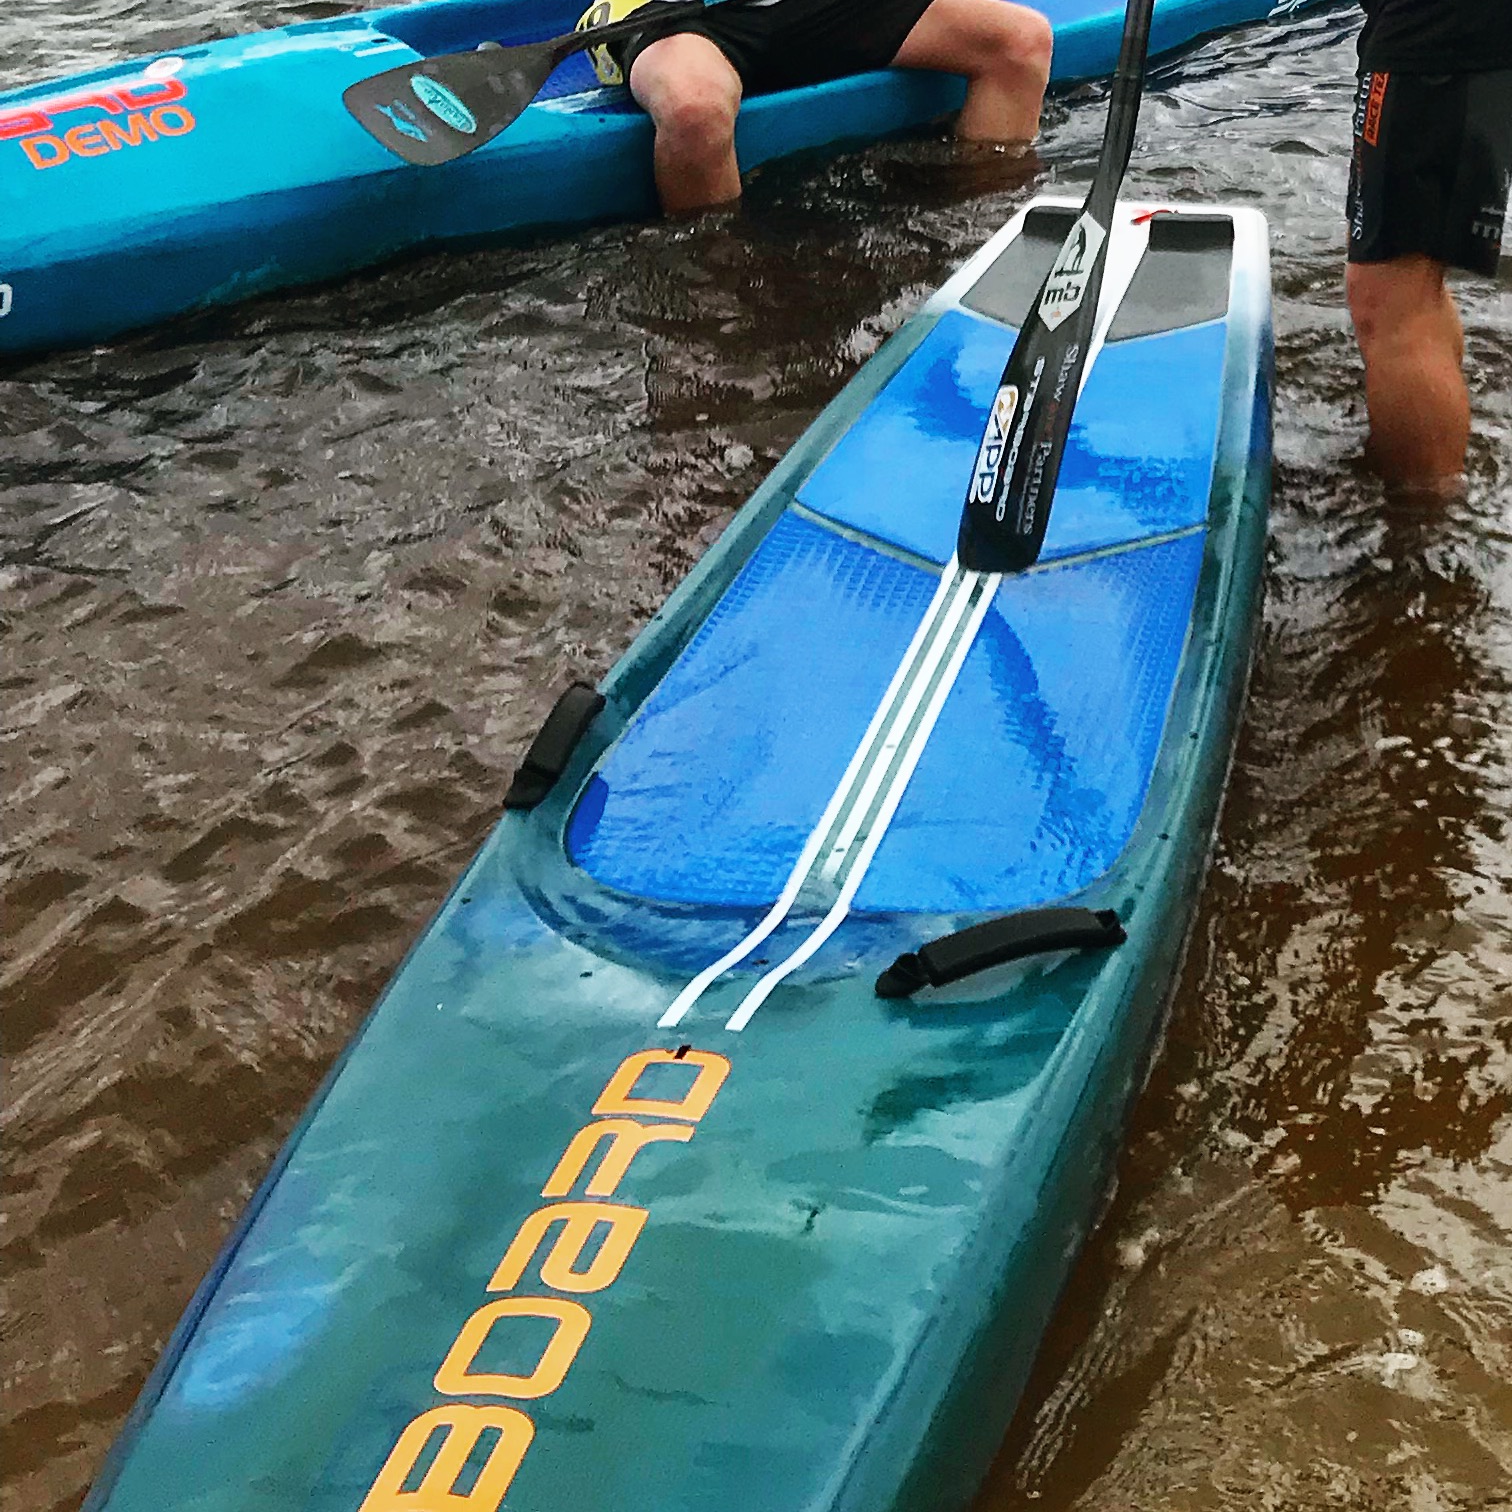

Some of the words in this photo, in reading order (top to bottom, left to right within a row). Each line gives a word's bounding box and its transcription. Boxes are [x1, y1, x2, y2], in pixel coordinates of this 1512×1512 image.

[19, 104, 196, 170] DEMO
[1053, 344, 1080, 402] Shaw
[1023, 441, 1053, 535] Partners
